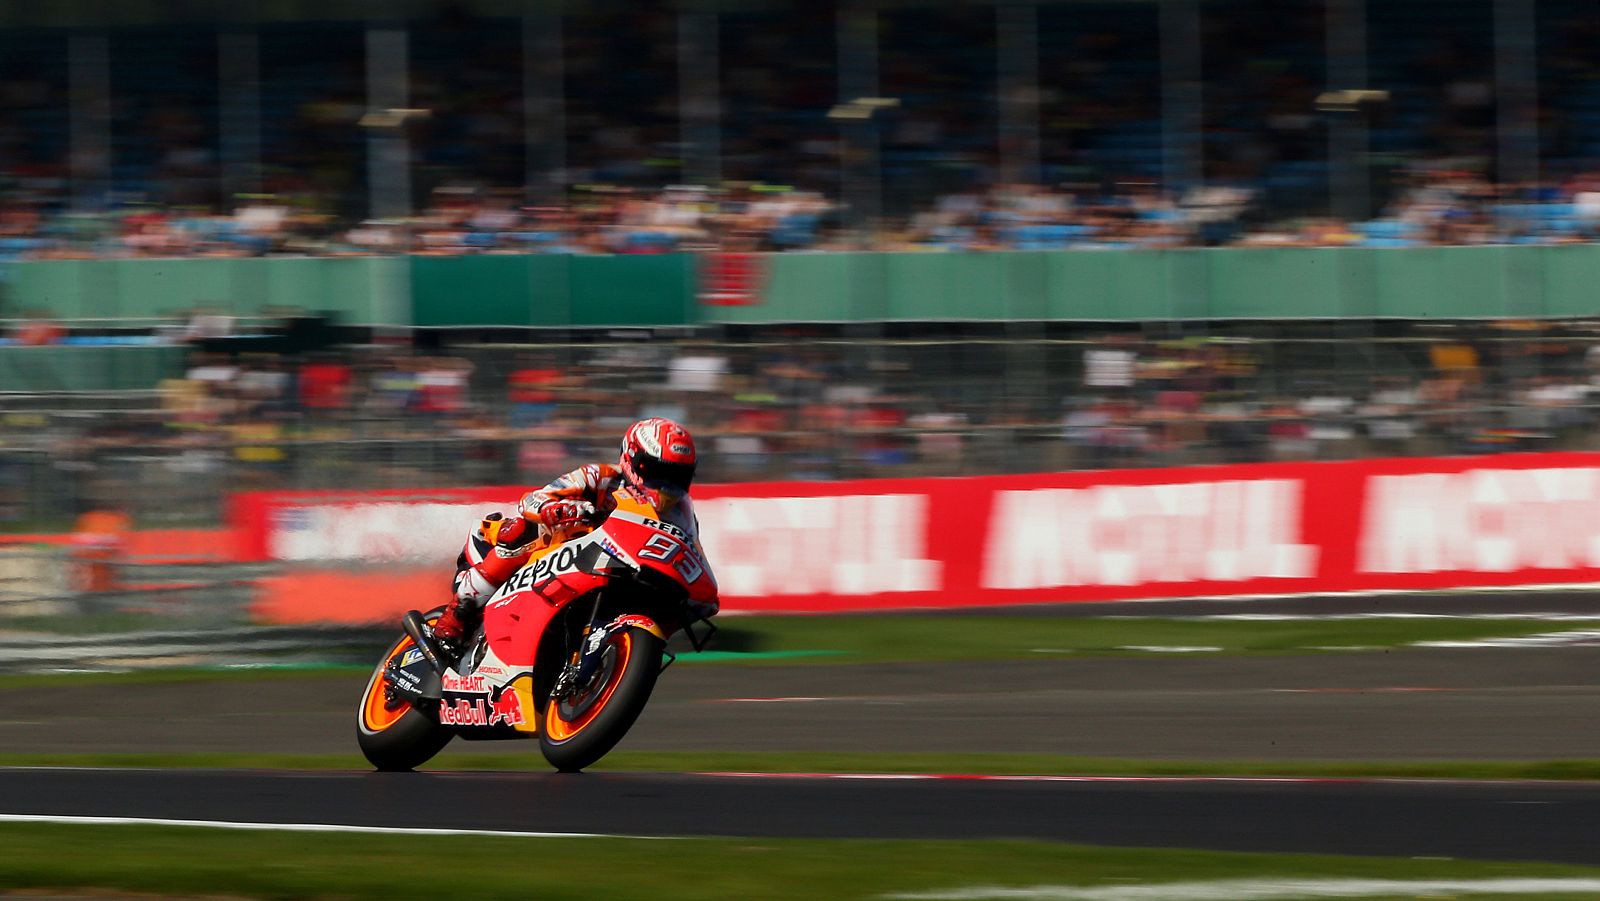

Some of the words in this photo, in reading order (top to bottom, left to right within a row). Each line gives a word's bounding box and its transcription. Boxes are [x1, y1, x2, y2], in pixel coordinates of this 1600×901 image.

[637, 533, 703, 584] 93
[692, 494, 944, 596] OTUL
[479, 665, 503, 674] HONDA
